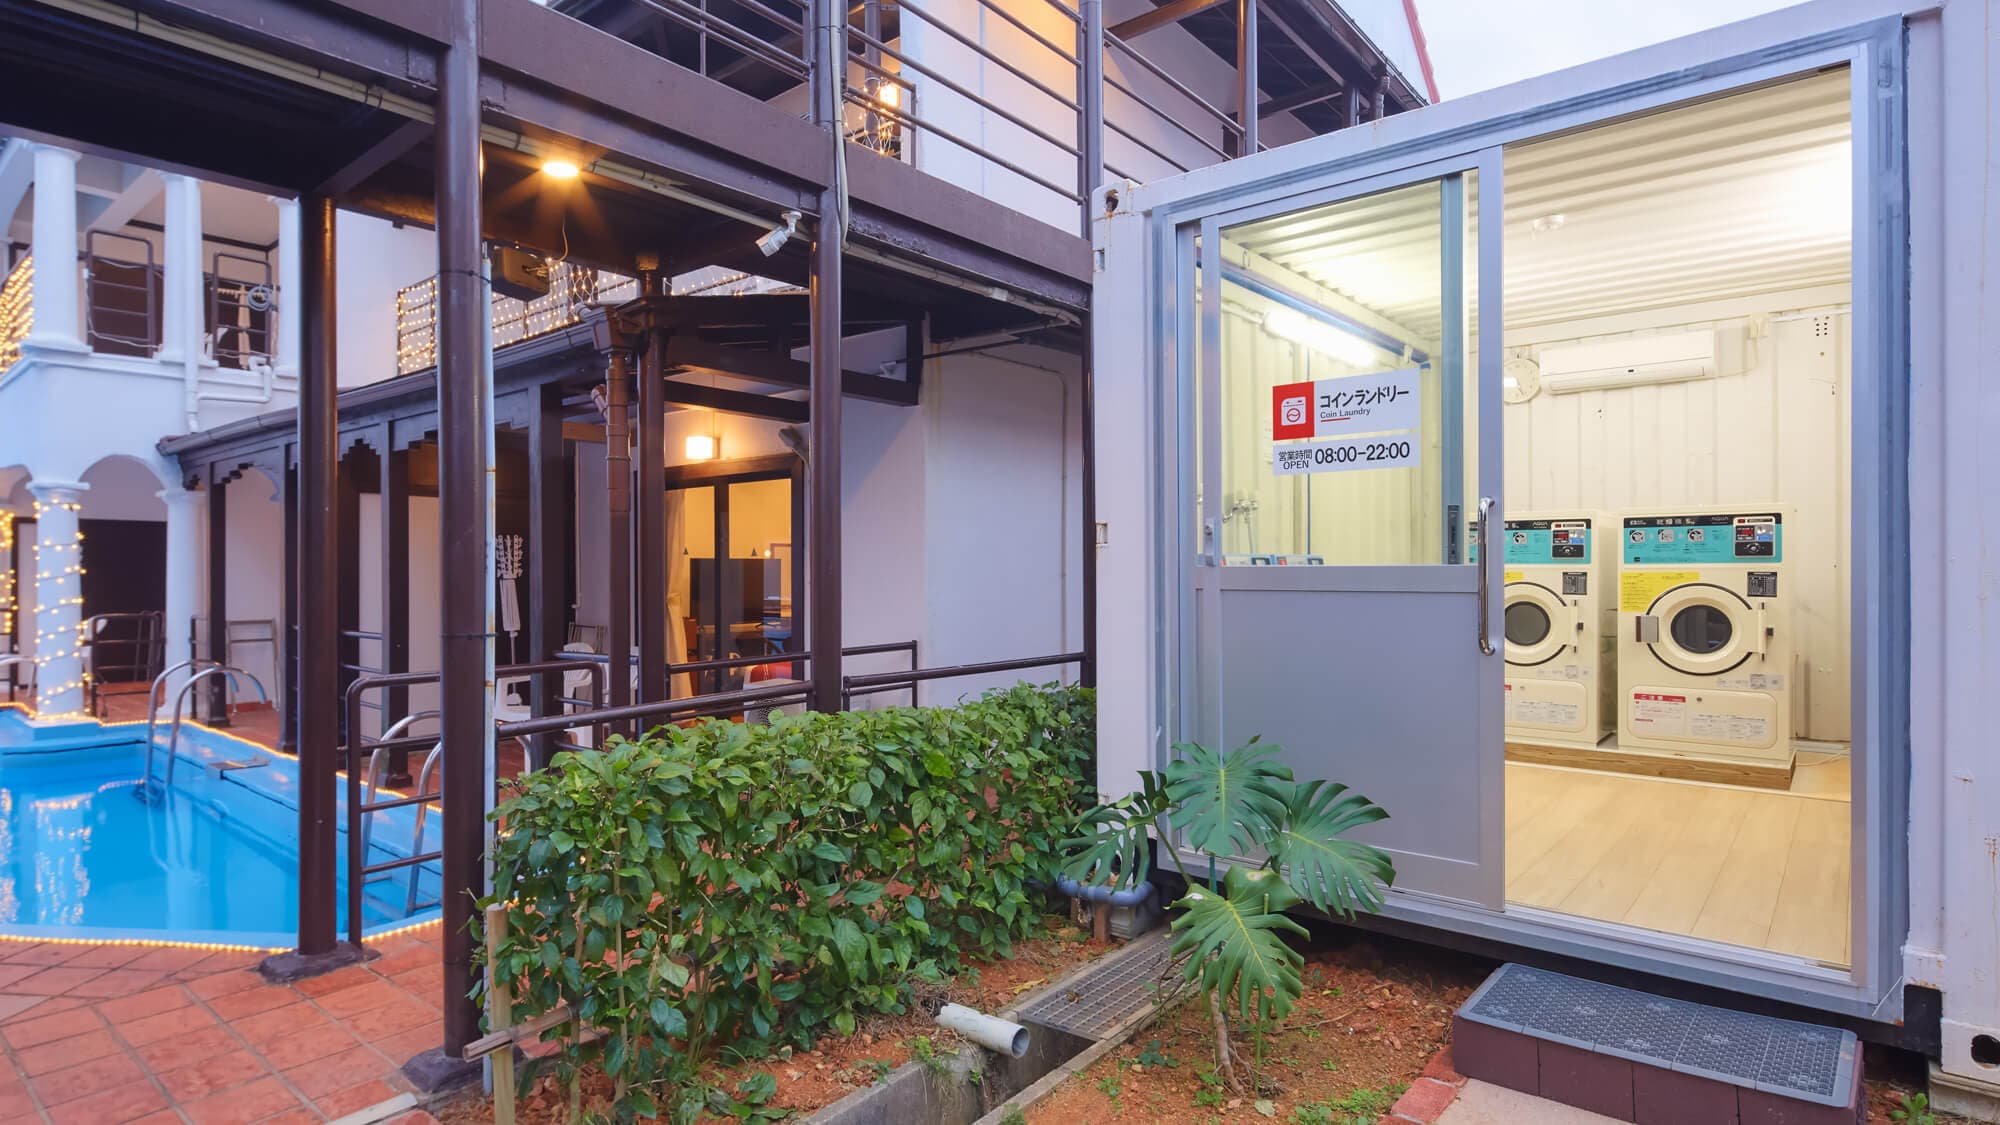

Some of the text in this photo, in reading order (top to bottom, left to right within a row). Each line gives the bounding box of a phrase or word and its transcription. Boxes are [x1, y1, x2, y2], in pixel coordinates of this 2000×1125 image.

[1320, 385, 1409, 409] コインランドリー
[1320, 407, 1371, 419] Coin Laundry
[1278, 449, 1312, 462] 営業時間
[1283, 460, 1309, 470] OPEN
